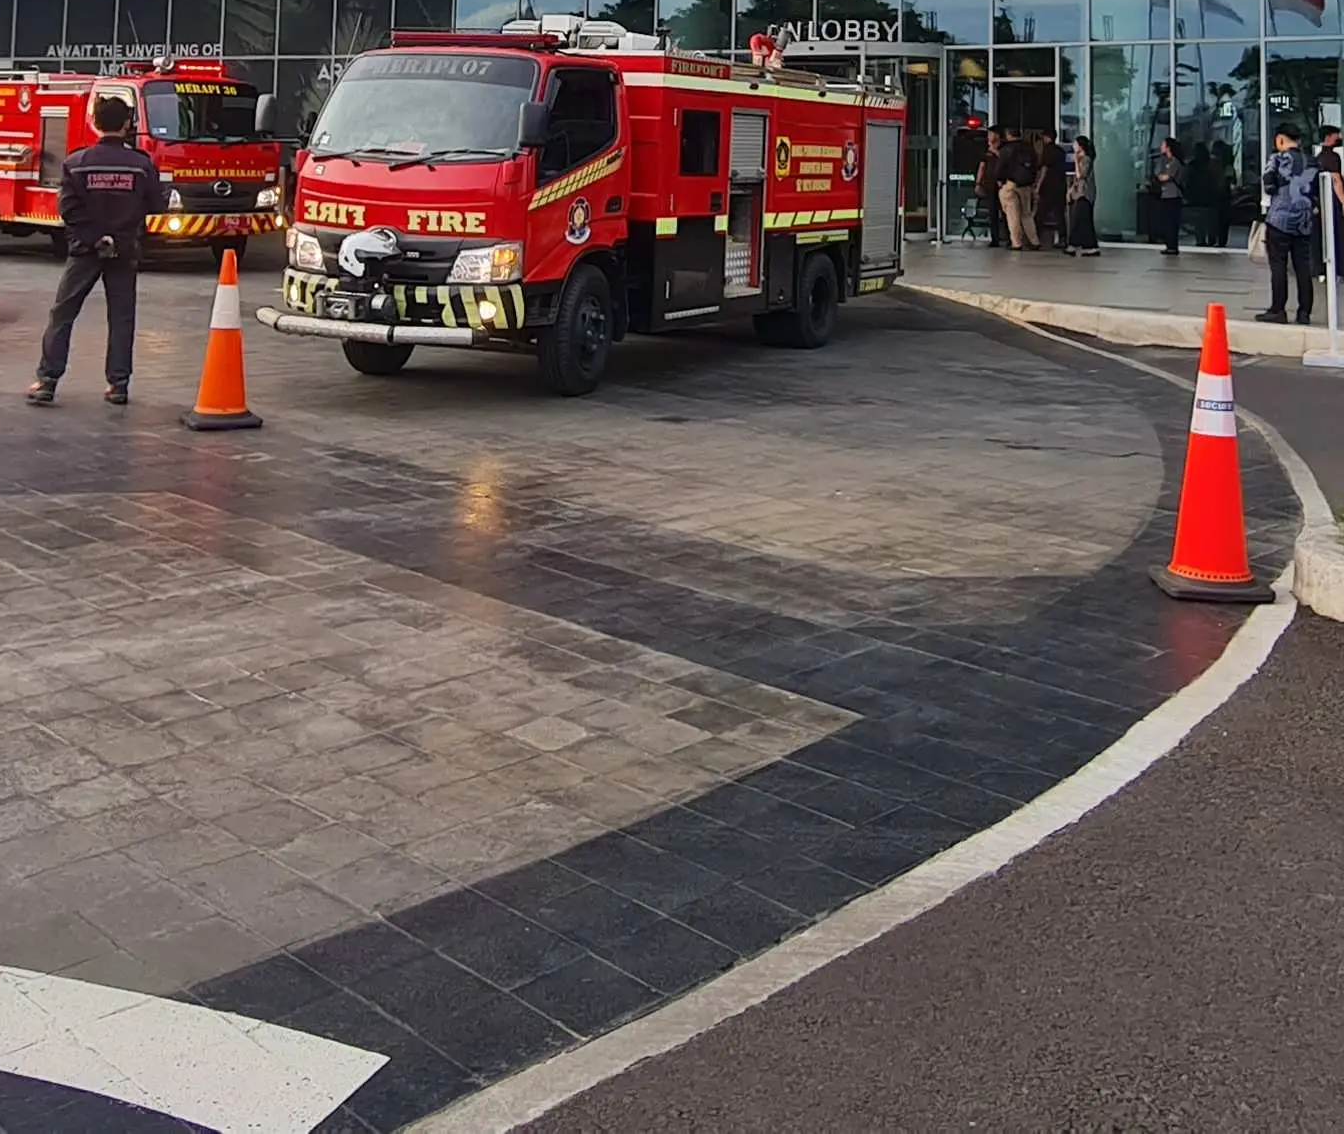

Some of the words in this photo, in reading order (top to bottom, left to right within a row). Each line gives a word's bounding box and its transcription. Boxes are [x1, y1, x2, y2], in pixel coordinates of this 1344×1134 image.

[808, 19, 899, 43] LOBBY
[46, 44, 94, 58] AWAIT
[95, 44, 123, 57] THE
[126, 43, 201, 57] UNVEILING
[203, 43, 223, 56] OF
[461, 59, 493, 76] 07
[174, 82, 221, 95] MERAPI
[406, 209, 487, 234] FIRE
